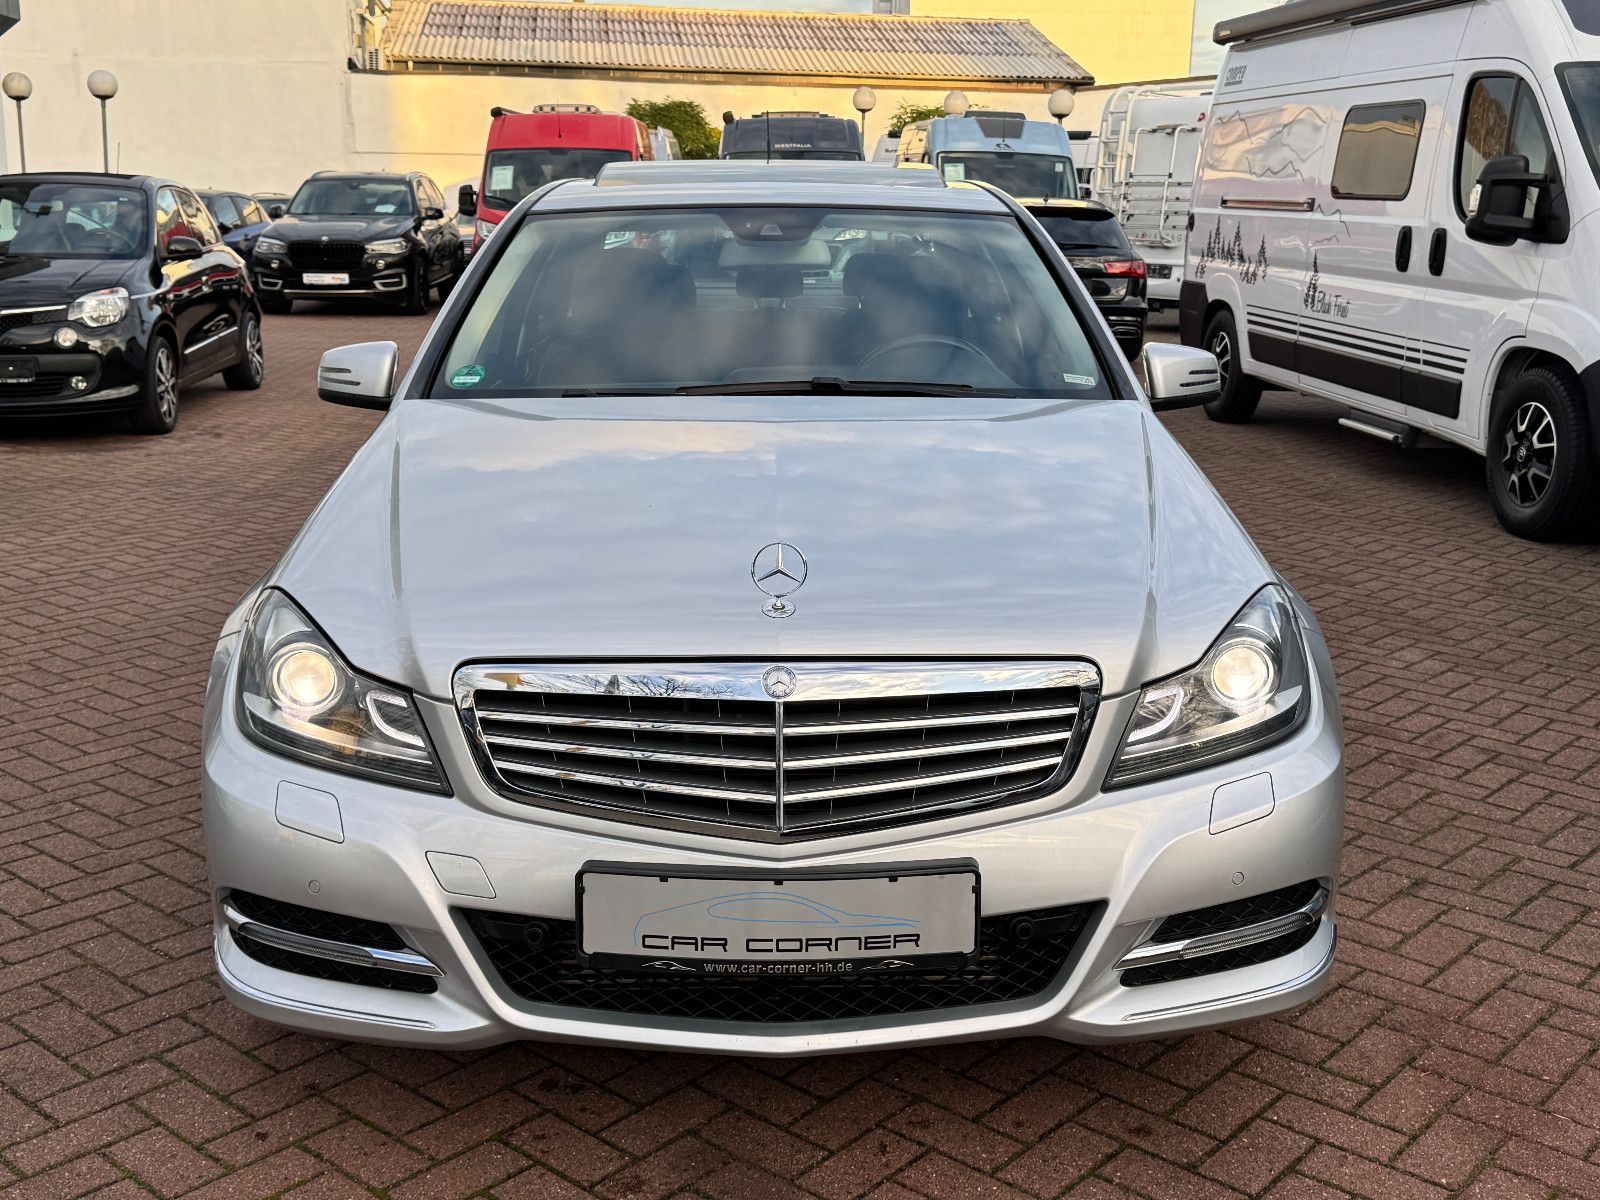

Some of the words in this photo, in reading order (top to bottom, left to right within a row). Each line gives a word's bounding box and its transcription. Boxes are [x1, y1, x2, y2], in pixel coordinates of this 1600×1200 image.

[641, 934, 728, 953] CAR
[745, 933, 921, 953] CORNER
[703, 961, 854, 974] www.car-corner-hh.de
